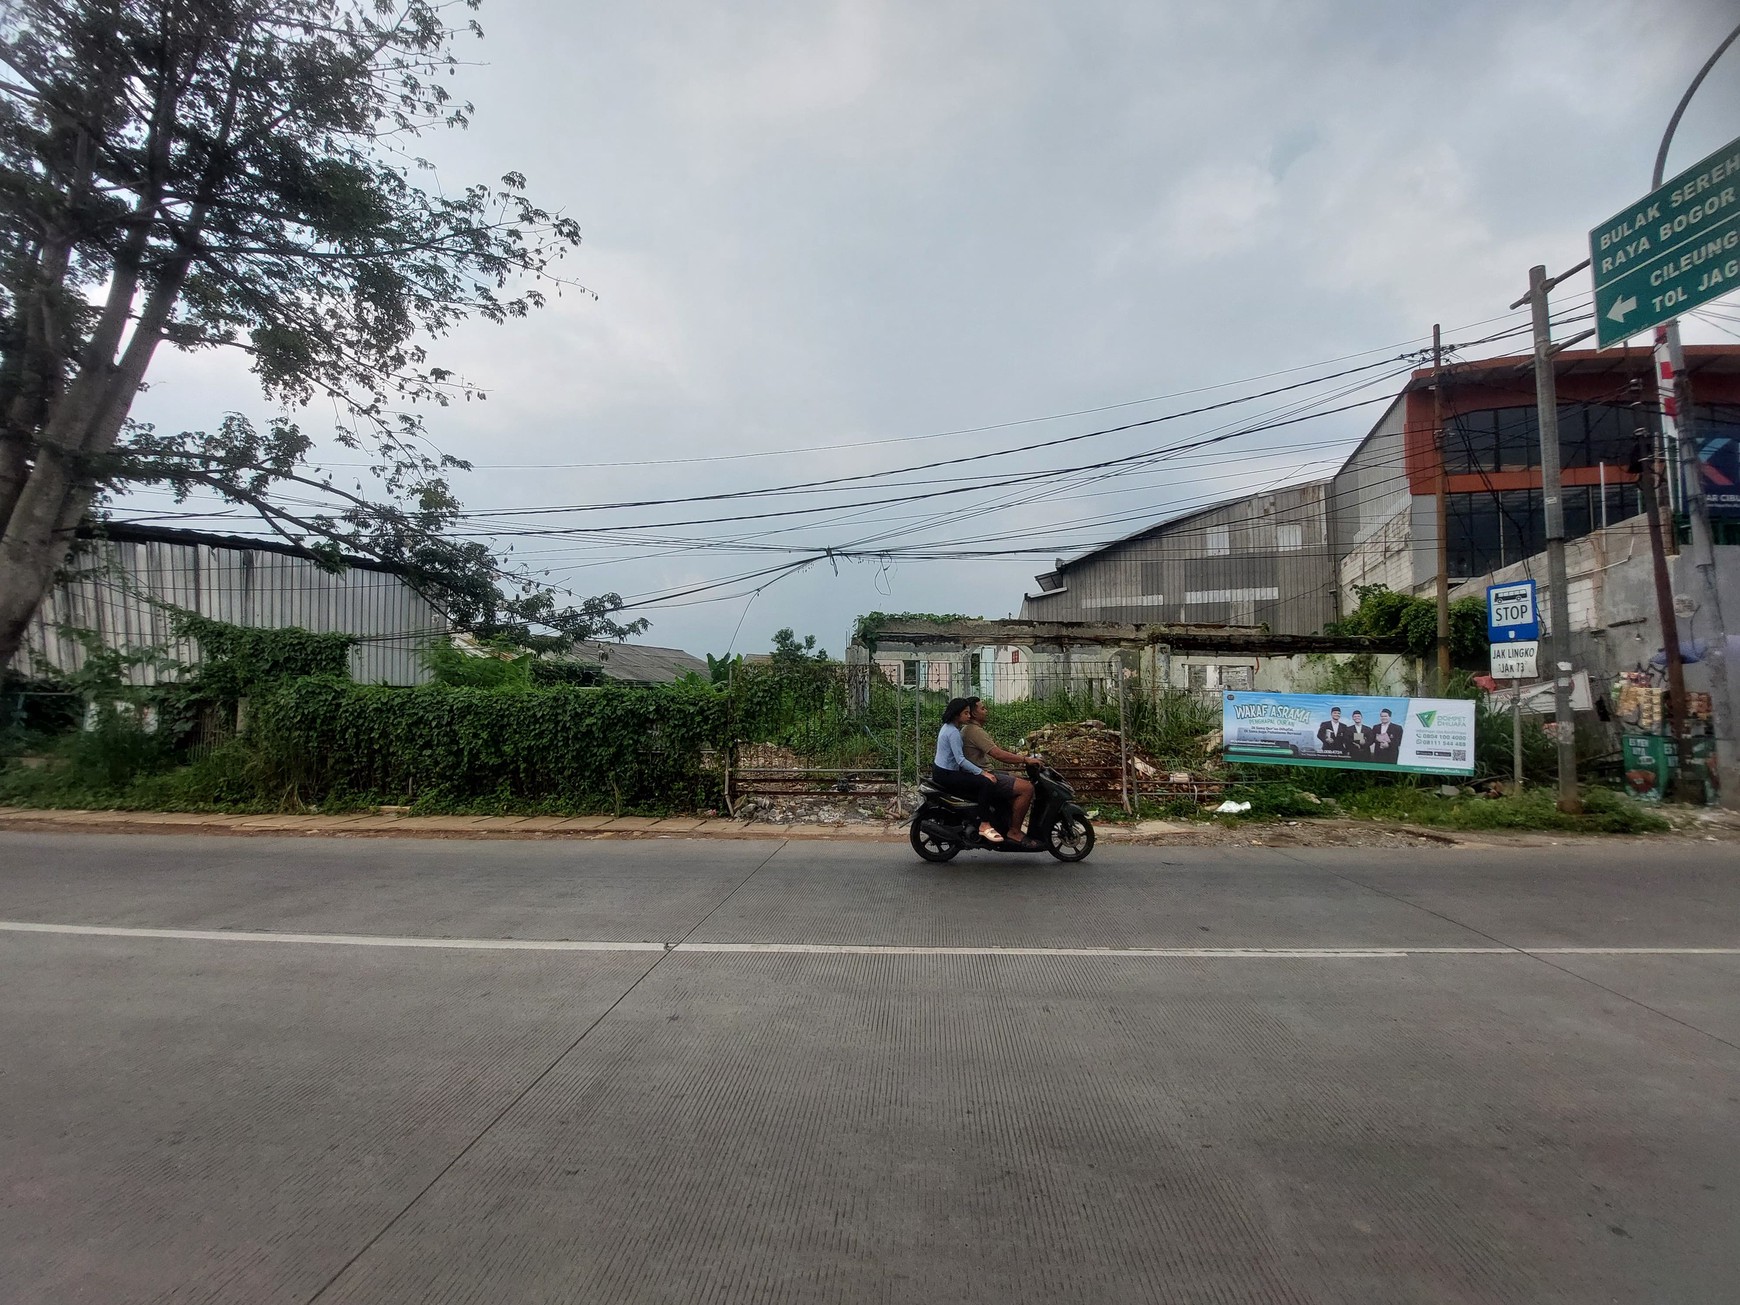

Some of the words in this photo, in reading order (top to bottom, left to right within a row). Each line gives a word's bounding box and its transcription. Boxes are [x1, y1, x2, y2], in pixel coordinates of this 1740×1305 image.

[1600, 202, 1661, 250] BULAK
[1602, 237, 1651, 274] RAYA
[1660, 187, 1736, 242] BOGOR
[1650, 230, 1739, 287] CILEUNG
[1651, 286, 1688, 312] TOL
[1698, 260, 1739, 292] JAG
[1496, 604, 1528, 622] STOP
[1492, 649, 1506, 659] JAK
[1508, 648, 1534, 658] LINGKO
[1516, 662, 1525, 672] 73
[1234, 704, 1268, 719] WAKAF
[1270, 705, 1312, 724] ASRAMA
